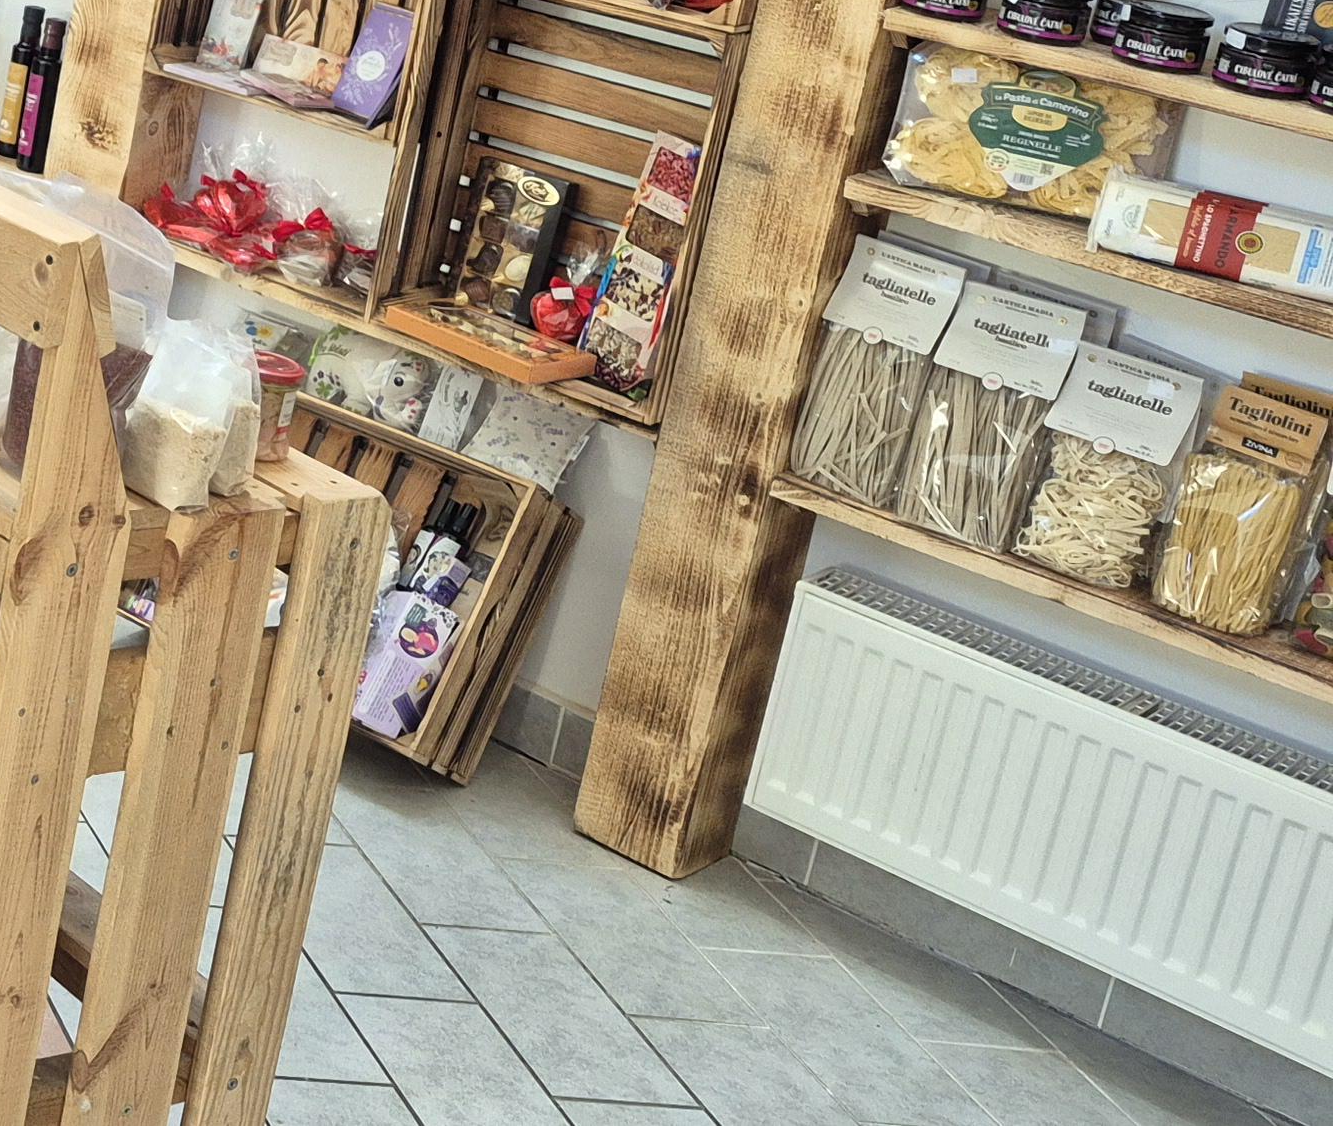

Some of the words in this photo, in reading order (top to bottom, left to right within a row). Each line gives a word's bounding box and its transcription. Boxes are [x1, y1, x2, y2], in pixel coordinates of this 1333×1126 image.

[1006, 9, 1041, 26] CIBULOVÉ
[1041, 14, 1064, 31] ČATNÍ
[1126, 38, 1163, 55] CIBULOVÉ
[1164, 42, 1187, 59] ČATNÍ
[1234, 64, 1273, 80] CIBULOVÉ
[1273, 68, 1299, 85] ČATNÍ
[1003, 92, 1032, 105] Pasta
[1039, 97, 1090, 119] Camerino
[1002, 134, 1062, 153] REGINELLE
[1192, 213, 1212, 263] SPAGHETTINO
[1215, 208, 1238, 270] ARMANDO
[862, 272, 937, 306] tagliatelle
[973, 317, 1050, 349] tagliatell
[1088, 379, 1173, 416] tagliatelle
[1229, 396, 1313, 437] Tagliolini
[1244, 440, 1274, 456] ZIVINA
